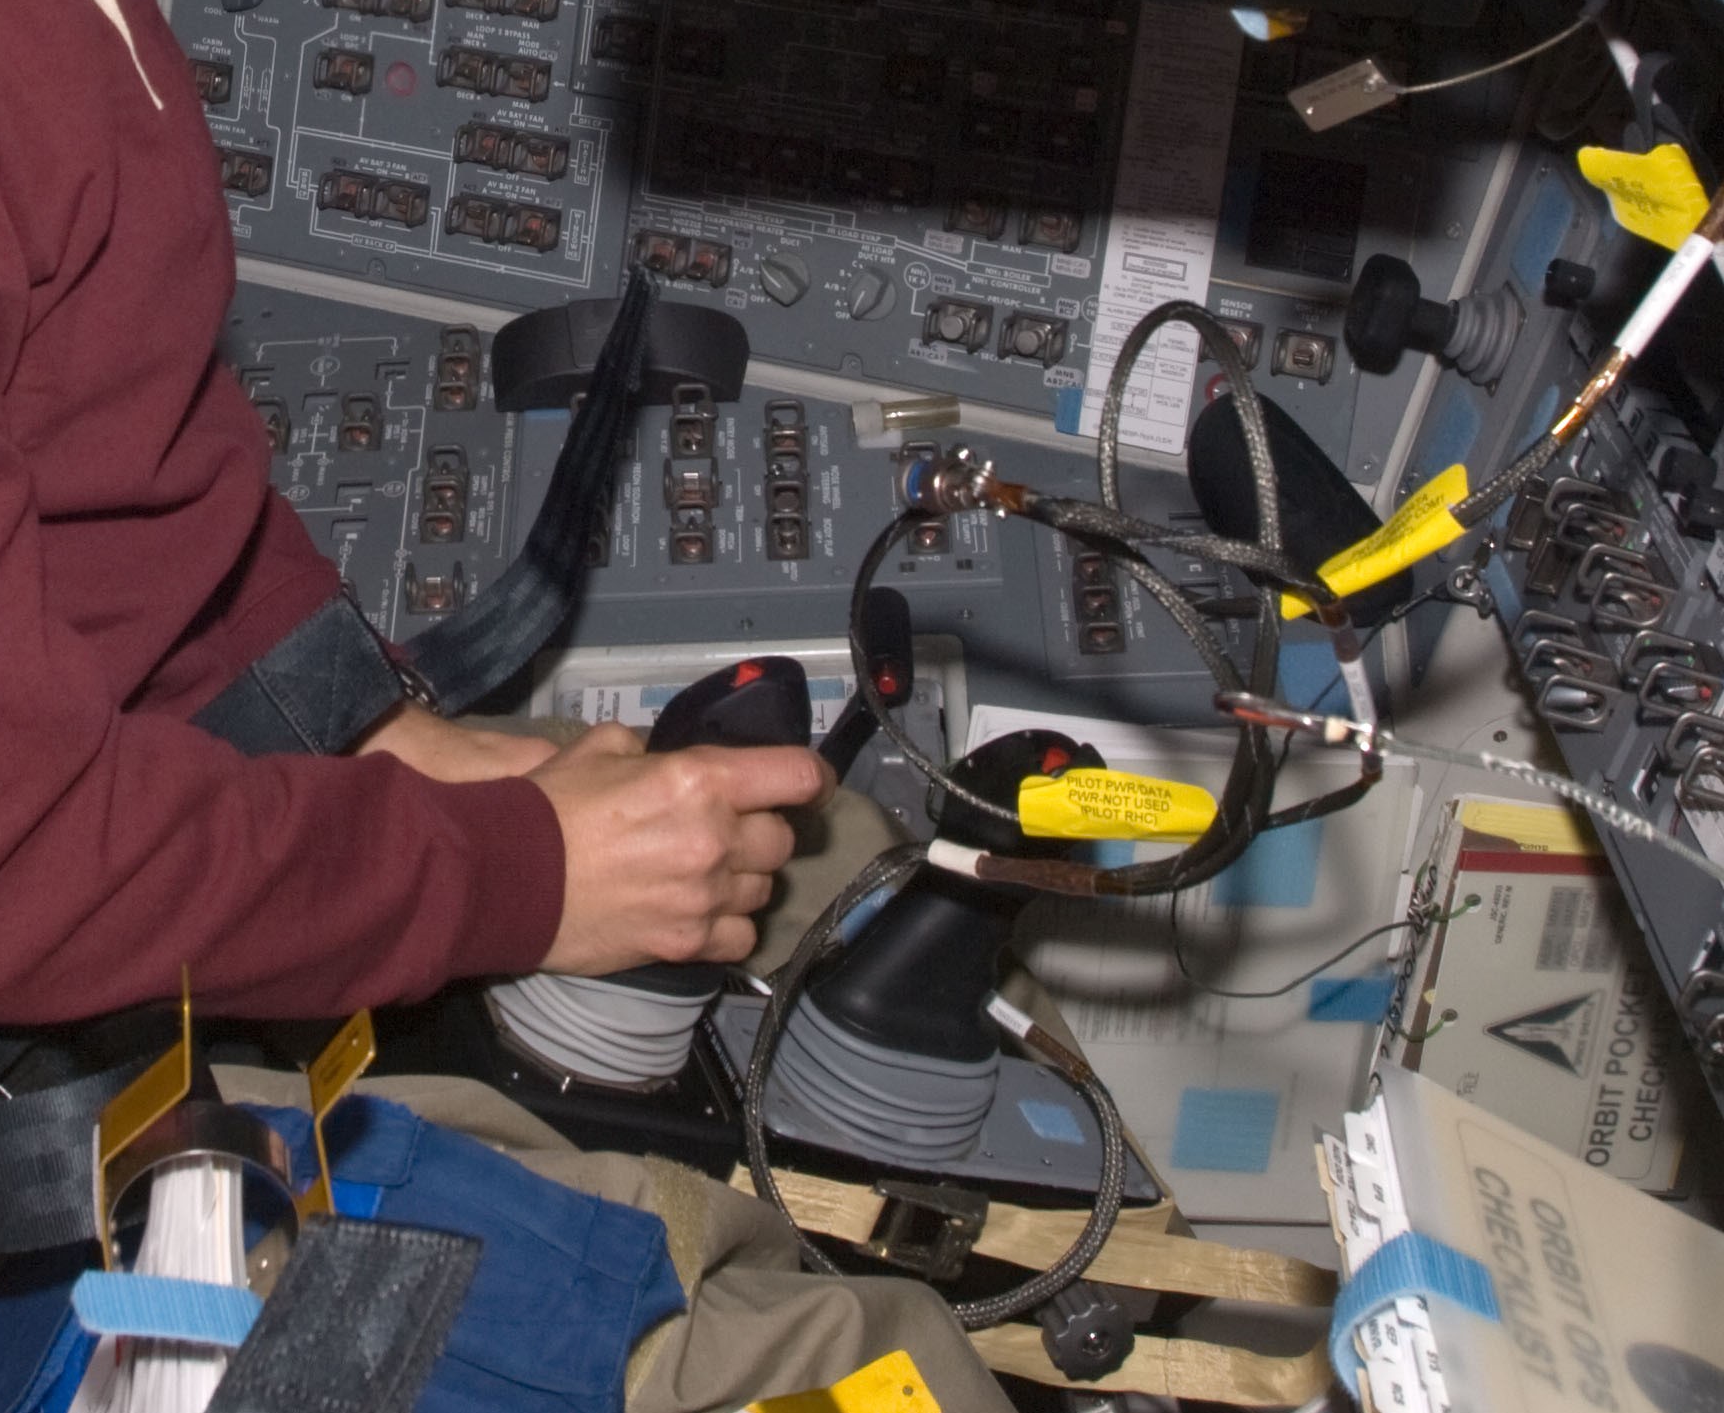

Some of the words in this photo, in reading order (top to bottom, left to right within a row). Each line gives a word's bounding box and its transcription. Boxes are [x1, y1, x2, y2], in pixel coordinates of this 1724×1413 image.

[203, 6, 223, 16] COOL
[521, 21, 540, 31] MAN
[466, 31, 485, 41] MAN
[475, 25, 496, 35] LOOP
[504, 29, 531, 40] BYPASS
[202, 37, 223, 47] CABIN
[518, 40, 540, 50] MODE
[192, 43, 210, 53] TEMP
[518, 48, 539, 57] AUTO
[511, 101, 531, 111] MAN
[497, 109, 507, 117] AV
[507, 111, 523, 120] BAY
[529, 114, 545, 124] FAN
[210, 122, 232, 134] CABIN
[232, 126, 247, 136] FAN
[513, 120, 526, 129] ON
[220, 139, 233, 148] ON
[375, 167, 389, 176] ON
[392, 162, 408, 172] FAN
[505, 173, 521, 182] OFF
[487, 180, 498, 188] AV
[520, 186, 537, 196] FAN
[505, 191, 518, 200] ON
[368, 220, 384, 229] OFF
[680, 227, 702, 237] AUTO
[756, 224, 785, 236] HEATER
[827, 227, 837, 235] HI
[837, 228, 860, 239] LOAD
[860, 233, 882, 243] EVAP
[780, 237, 800, 248] DUCT
[497, 244, 513, 254] OFF
[861, 244, 872, 253] HI
[871, 246, 894, 257] LOAD
[1001, 244, 1023, 255] MAN
[857, 251, 879, 262] DUCT
[739, 266, 754, 276] A/B
[1003, 270, 1032, 282] BOILER
[672, 281, 694, 292] AUTO
[990, 279, 1042, 295] CONTROLLER
[750, 294, 766, 304] OFF
[1220, 298, 1254, 311] SENSOR
[835, 311, 851, 321] OFF
[1219, 307, 1244, 319] RESET
[1305, 323, 1314, 331] A
[1066, 775, 1103, 790] PILOT
[1104, 779, 1173, 799] PWR/DATA
[1068, 789, 1131, 808] PWR-NOT
[1133, 798, 1171, 814] USED
[1124, 809, 1158, 826] RHC)
[1584, 1083, 1625, 1168] ORBIT
[1474, 1165, 1564, 1394] CHECKLIST
[1528, 1197, 1595, 1323] ORBIT
[1563, 1322, 1620, 1413] OPS
